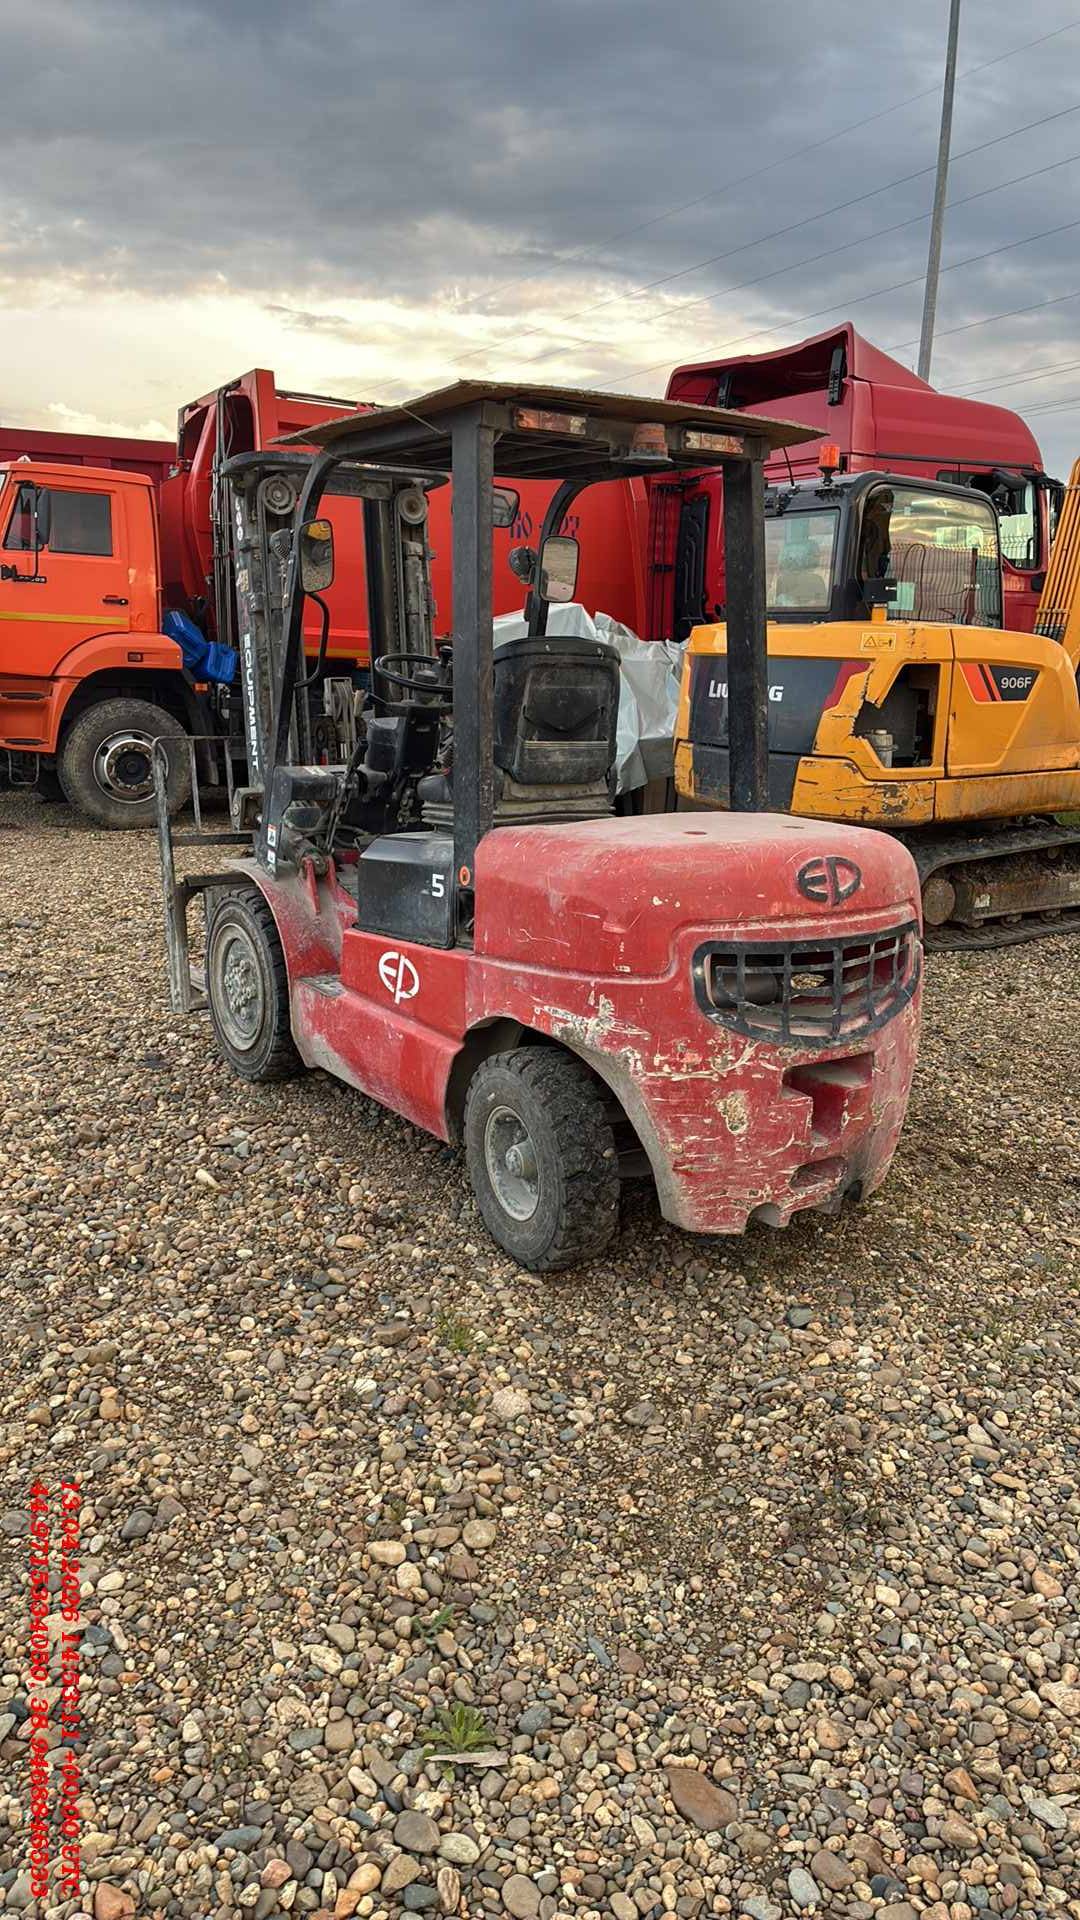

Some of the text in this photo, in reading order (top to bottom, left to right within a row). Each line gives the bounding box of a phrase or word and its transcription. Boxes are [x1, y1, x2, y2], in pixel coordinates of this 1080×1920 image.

[243, 633, 259, 770] EQUIPMENT
[1001, 676, 1032, 689] 906F
[378, 951, 420, 1005] EP
